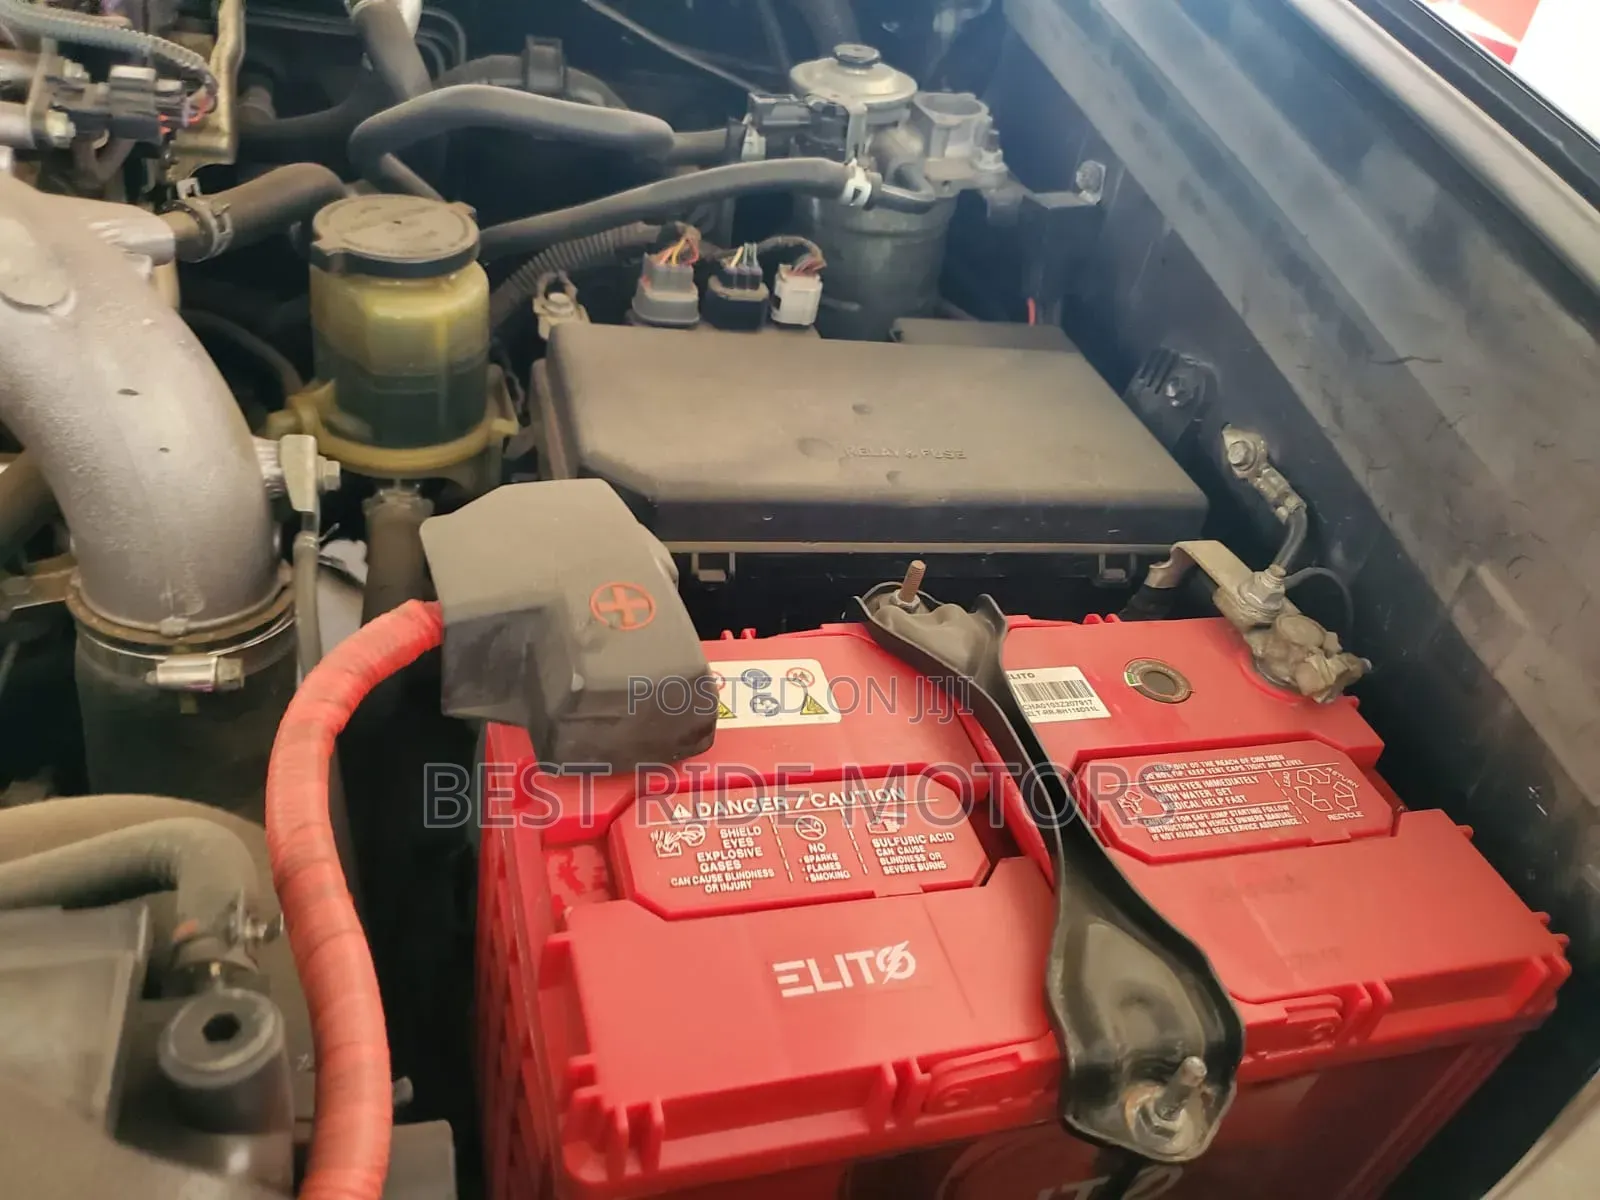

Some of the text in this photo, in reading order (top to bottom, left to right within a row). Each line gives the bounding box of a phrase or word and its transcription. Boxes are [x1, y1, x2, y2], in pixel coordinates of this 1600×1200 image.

[920, 448, 967, 459] FUSE
[1148, 775, 1259, 793] FLUSH EYES IMMEDIATELY
[1216, 787, 1232, 796] GET
[696, 788, 905, 817] DANGER / CAUTION
[1202, 797, 1225, 807] HELP
[1225, 794, 1248, 804] FAST
[1327, 811, 1365, 821] RECYCLE
[720, 826, 761, 839] SHIELD
[722, 837, 754, 849] EYES
[872, 832, 955, 848] SULFURIC ACID
[697, 847, 763, 862] EXPLOSIVE
[808, 843, 826, 853] NO
[876, 845, 926, 857] CAN CAUSE
[803, 853, 839, 864] SPARKS
[879, 852, 942, 866] BLINDNESS OR
[700, 860, 742, 873] GASES
[807, 862, 842, 873] FLAMES
[883, 860, 947, 875] SEVERE BURNS
[670, 868, 775, 887] CAN CAUSE BLINDNESS
[810, 871, 850, 882] SMOKING
[705, 880, 752, 893] OR INJURY
